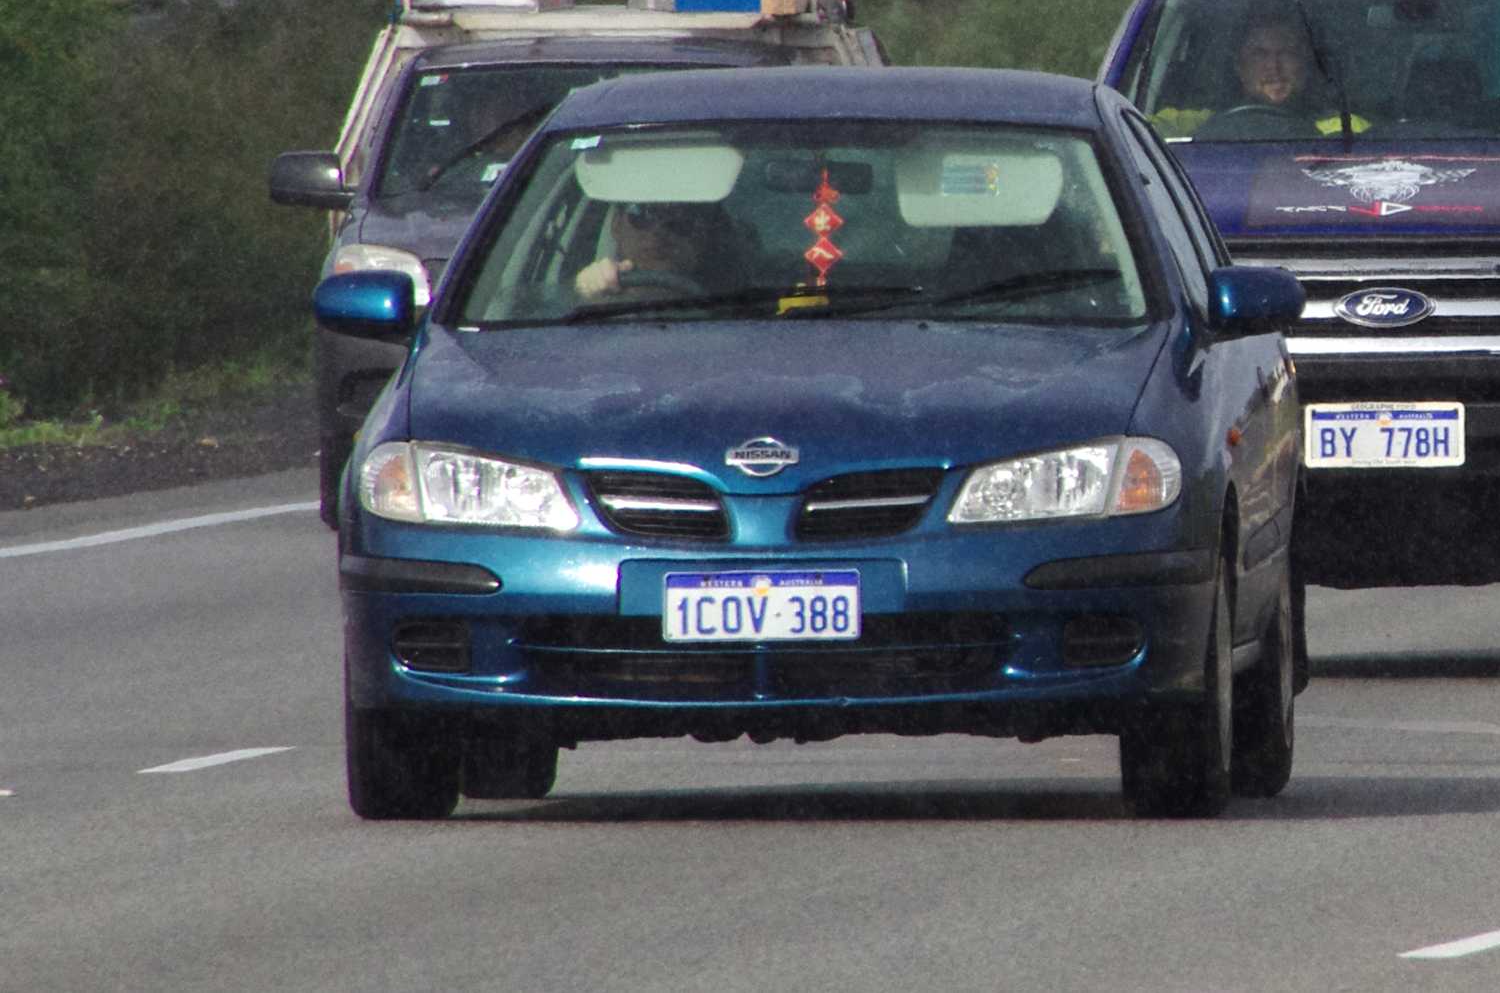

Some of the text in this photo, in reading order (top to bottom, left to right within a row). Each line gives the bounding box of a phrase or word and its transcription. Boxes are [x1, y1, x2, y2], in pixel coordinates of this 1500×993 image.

[1356, 294, 1409, 317] Ford
[1320, 427, 1450, 458] BY 778H
[734, 449, 792, 460] NISSAN
[700, 578, 824, 588] WESTERN AUSTRALIA
[677, 595, 849, 636] 1COV 388
